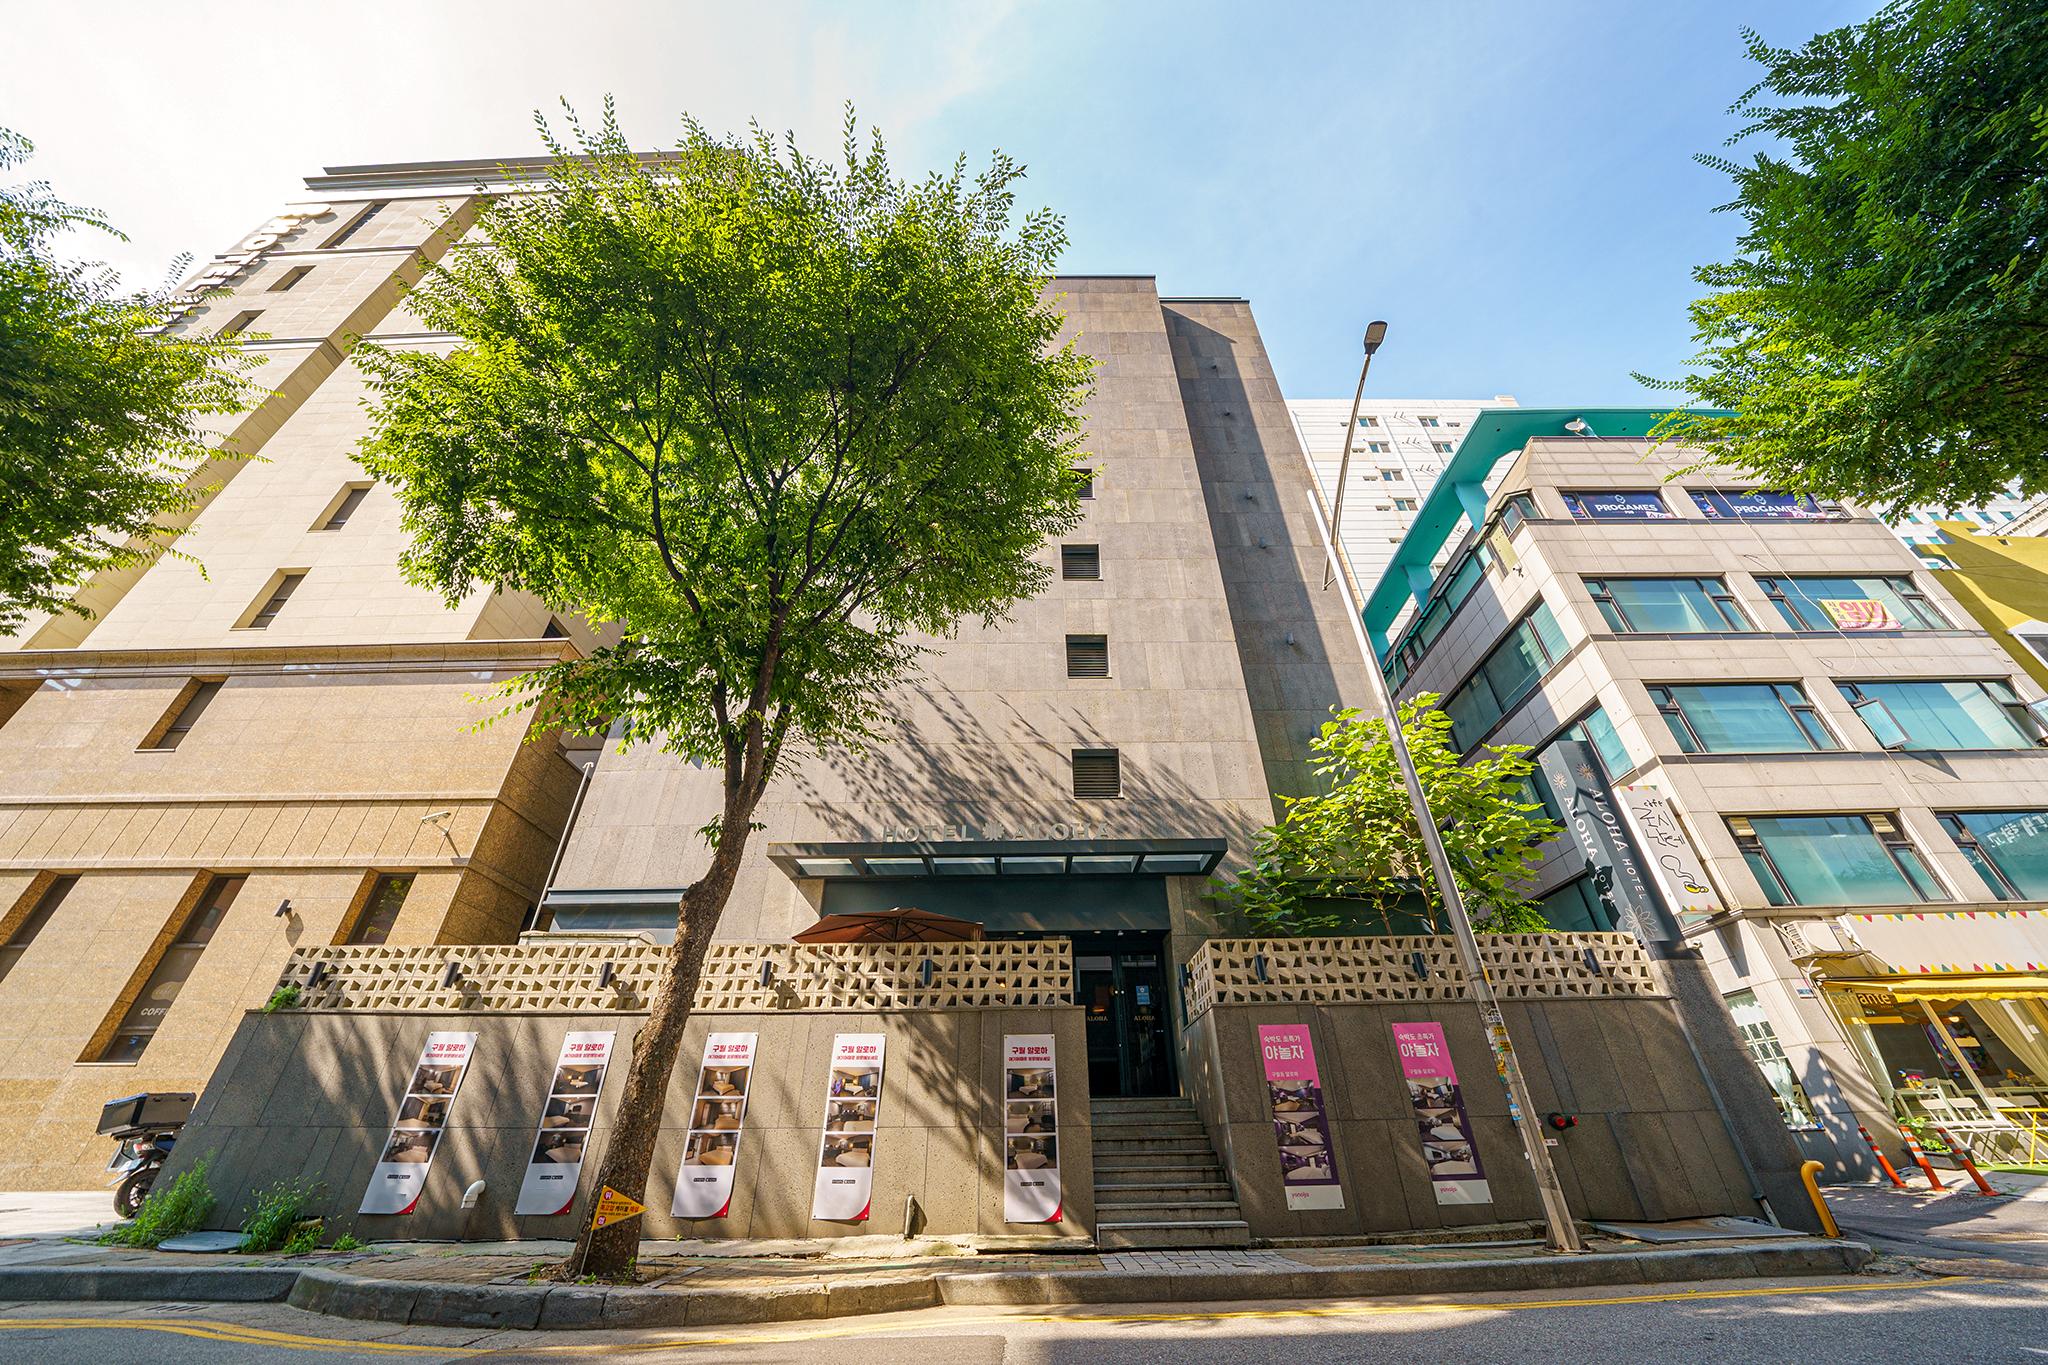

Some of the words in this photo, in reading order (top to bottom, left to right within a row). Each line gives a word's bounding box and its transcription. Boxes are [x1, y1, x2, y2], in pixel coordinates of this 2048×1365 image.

[1594, 504, 1658, 512] PROGAMES
[1733, 505, 1804, 514] PROGAMES
[883, 824, 974, 841] HOTEL
[1013, 823, 1110, 840] ALOHA
[1589, 788, 1630, 852] ALOHA
[1622, 858, 1648, 900] HOTEL
[1563, 797, 1599, 861] ALOHA
[1594, 865, 1617, 907] HOTEL
[432, 1043, 446, 1051] 구월
[445, 1043, 466, 1051] 알로하
[570, 1043, 583, 1051] 구월
[584, 1043, 605, 1051] 알로하
[713, 1044, 726, 1052] 구월
[727, 1044, 748, 1052] 알로하
[841, 1045, 854, 1053] 구월
[856, 1045, 877, 1053] 알로하
[1012, 1046, 1025, 1054] 구월
[1027, 1046, 1048, 1054] 알로하
[1400, 1042, 1440, 1057] 야놀자
[1265, 1045, 1304, 1060] 야놀자
